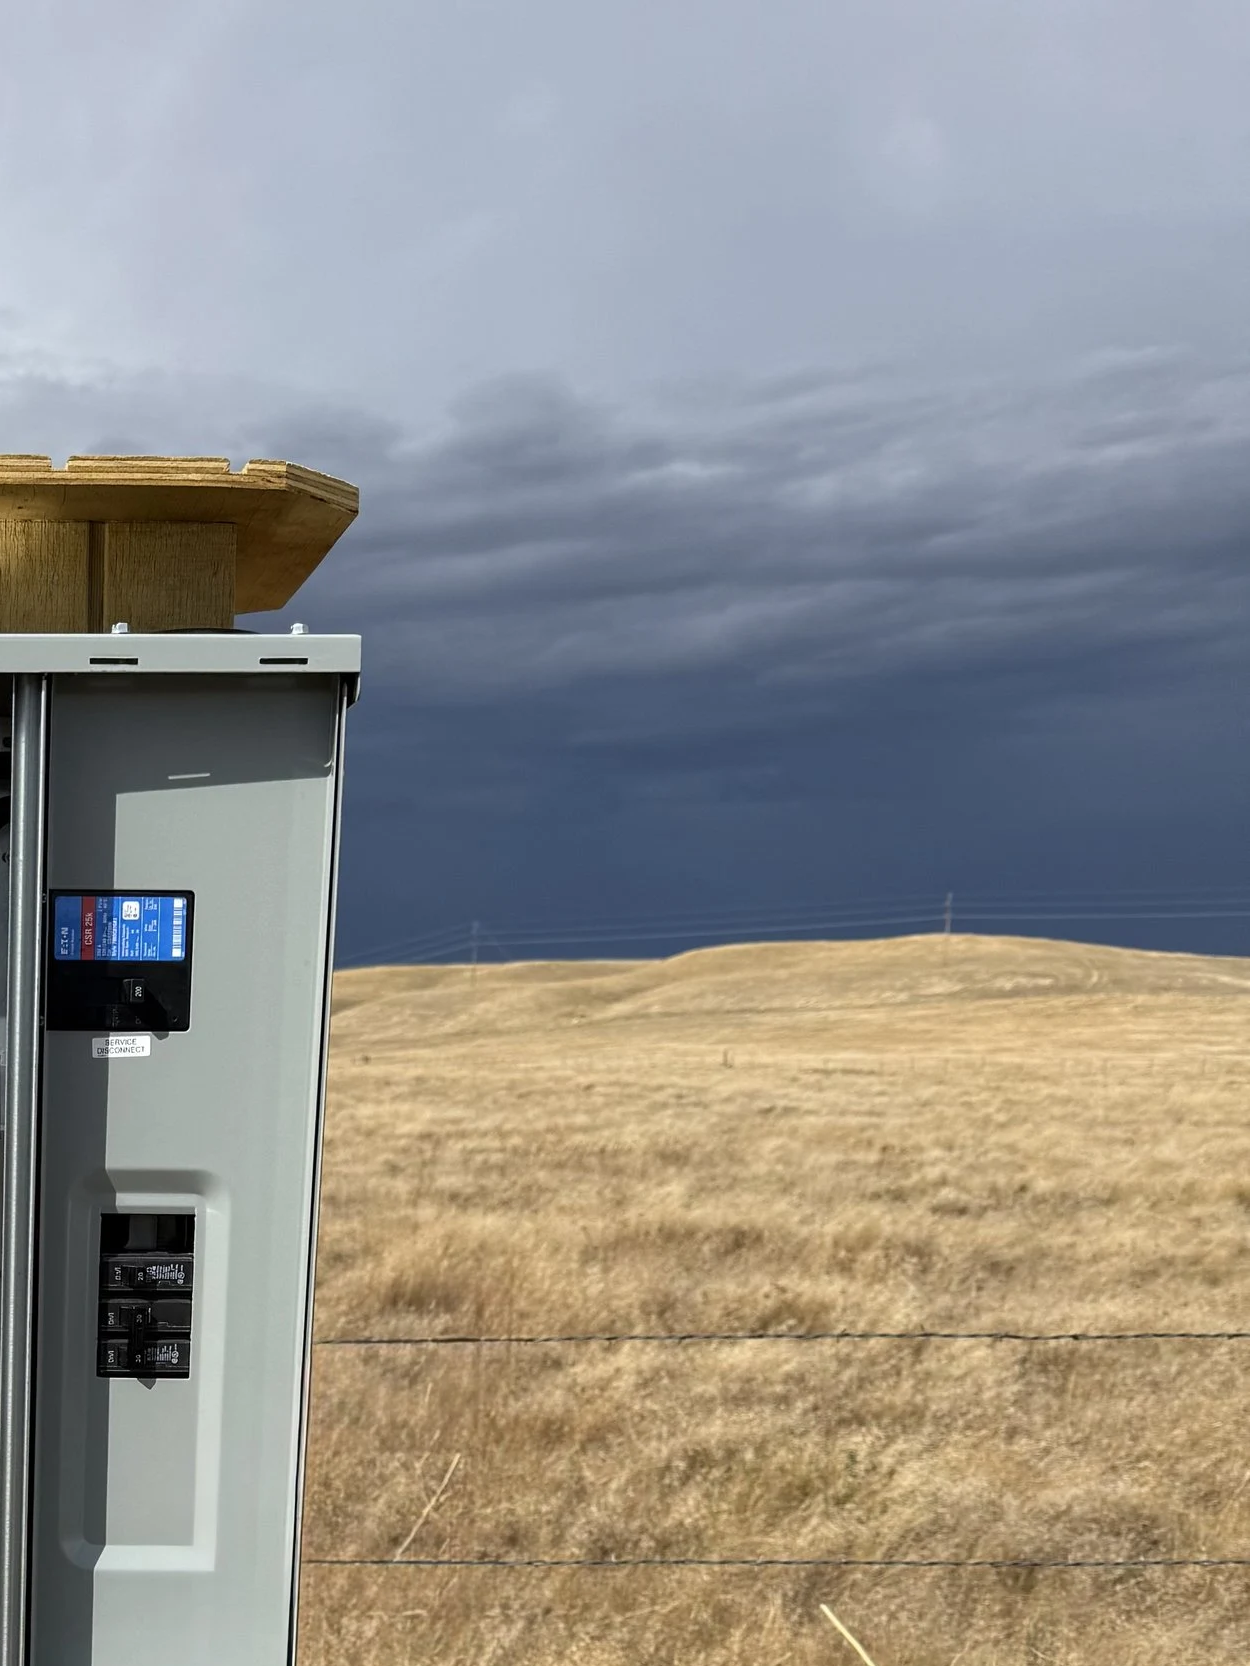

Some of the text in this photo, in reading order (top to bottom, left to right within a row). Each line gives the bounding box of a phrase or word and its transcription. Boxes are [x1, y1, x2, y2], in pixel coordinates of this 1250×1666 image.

[84, 928, 93, 945] CSR
[105, 1038, 137, 1046] SERVICE
[97, 1046, 145, 1054] DISCONNECT
[137, 1272, 144, 1281] 20
